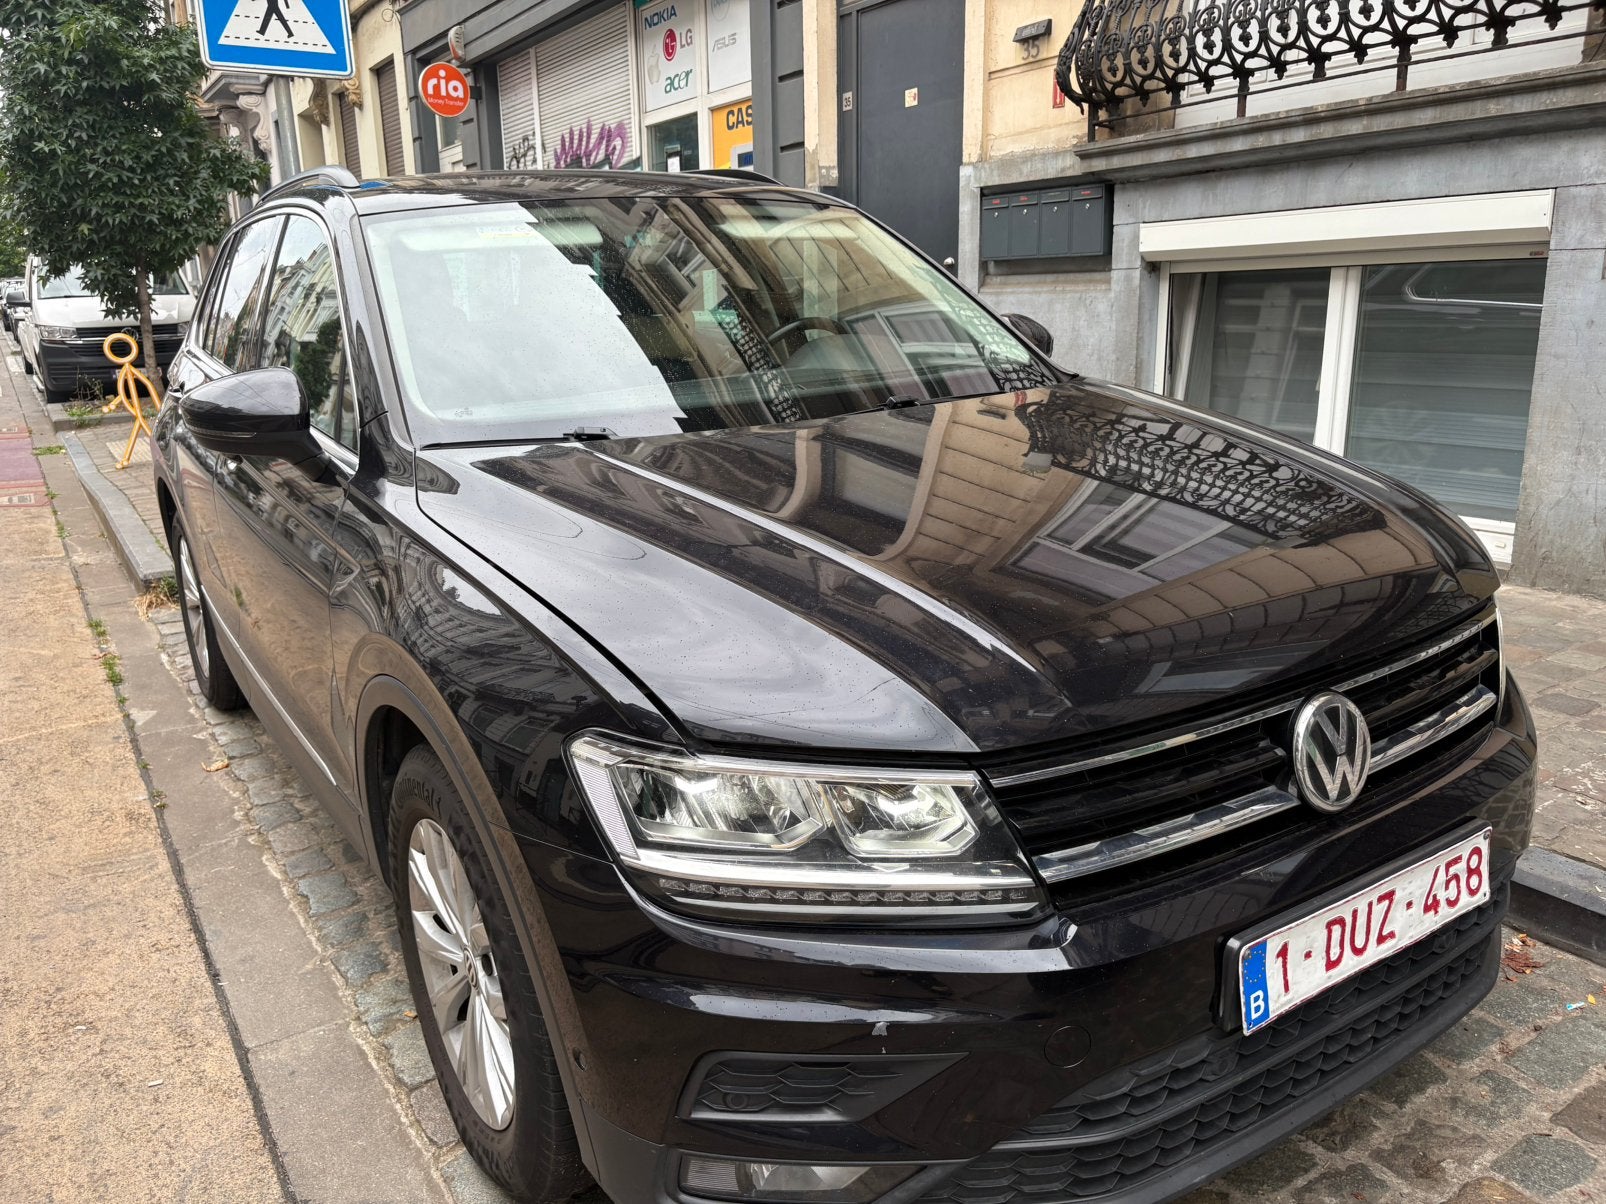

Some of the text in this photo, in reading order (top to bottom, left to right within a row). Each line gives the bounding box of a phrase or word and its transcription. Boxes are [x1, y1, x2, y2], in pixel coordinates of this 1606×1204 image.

[644, 5, 677, 30] NOKIA
[679, 28, 693, 49] LG
[712, 32, 737, 53] ASUS
[1022, 40, 1040, 60] 35
[427, 69, 464, 98] ria
[664, 69, 693, 94] acer
[427, 97, 444, 105] Money
[844, 96, 852, 108] 35
[1250, 990, 1265, 1021] B
